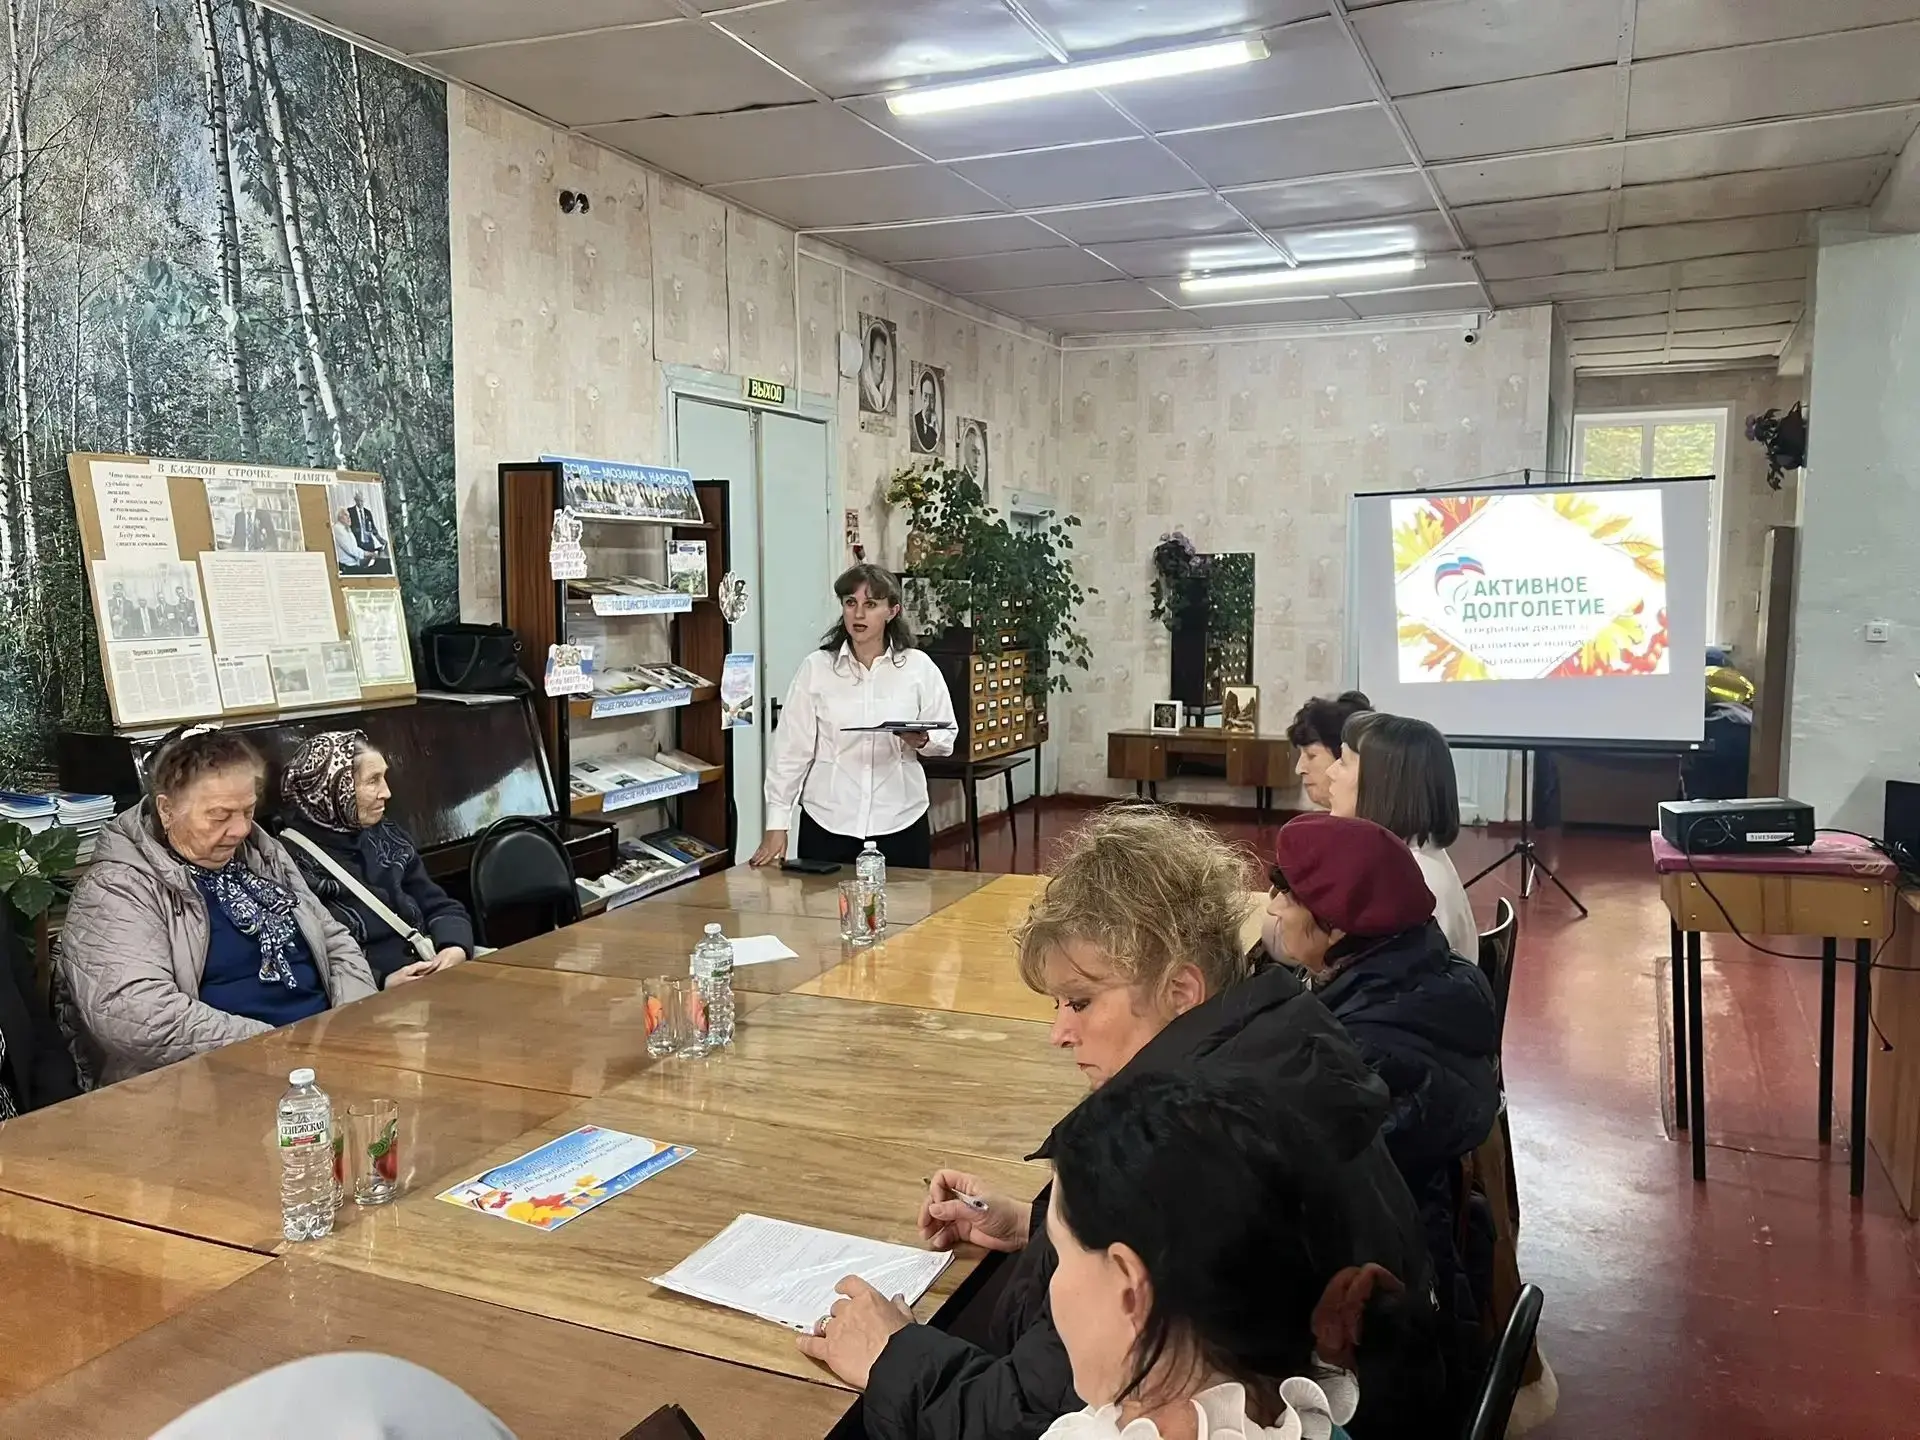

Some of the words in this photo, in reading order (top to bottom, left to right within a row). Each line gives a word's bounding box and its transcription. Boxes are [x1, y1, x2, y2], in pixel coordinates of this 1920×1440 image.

[751, 380, 782, 402] ВЫХОД
[157, 463, 165, 473] В
[170, 464, 216, 476] КАЖДОЙ
[293, 471, 332, 483] ПАМЯТЬ
[562, 462, 591, 477] ССИЯ
[602, 466, 647, 481] МОЗАИКА
[649, 470, 690, 487] НАРОДОВ
[1474, 576, 1588, 597] АКТИВНОЕ
[1462, 598, 1605, 623] ДОЛГОЛЕТИЕ
[594, 701, 615, 712] ОБЩЕЕ
[615, 698, 643, 710] ПРОШЛОЕ
[648, 696, 667, 706] ОБЩАЯ
[612, 790, 636, 804] ВМЕСТЕ
[636, 788, 645, 798] НА
[281, 1120, 326, 1135] СЕНЕЖСКАЯ
